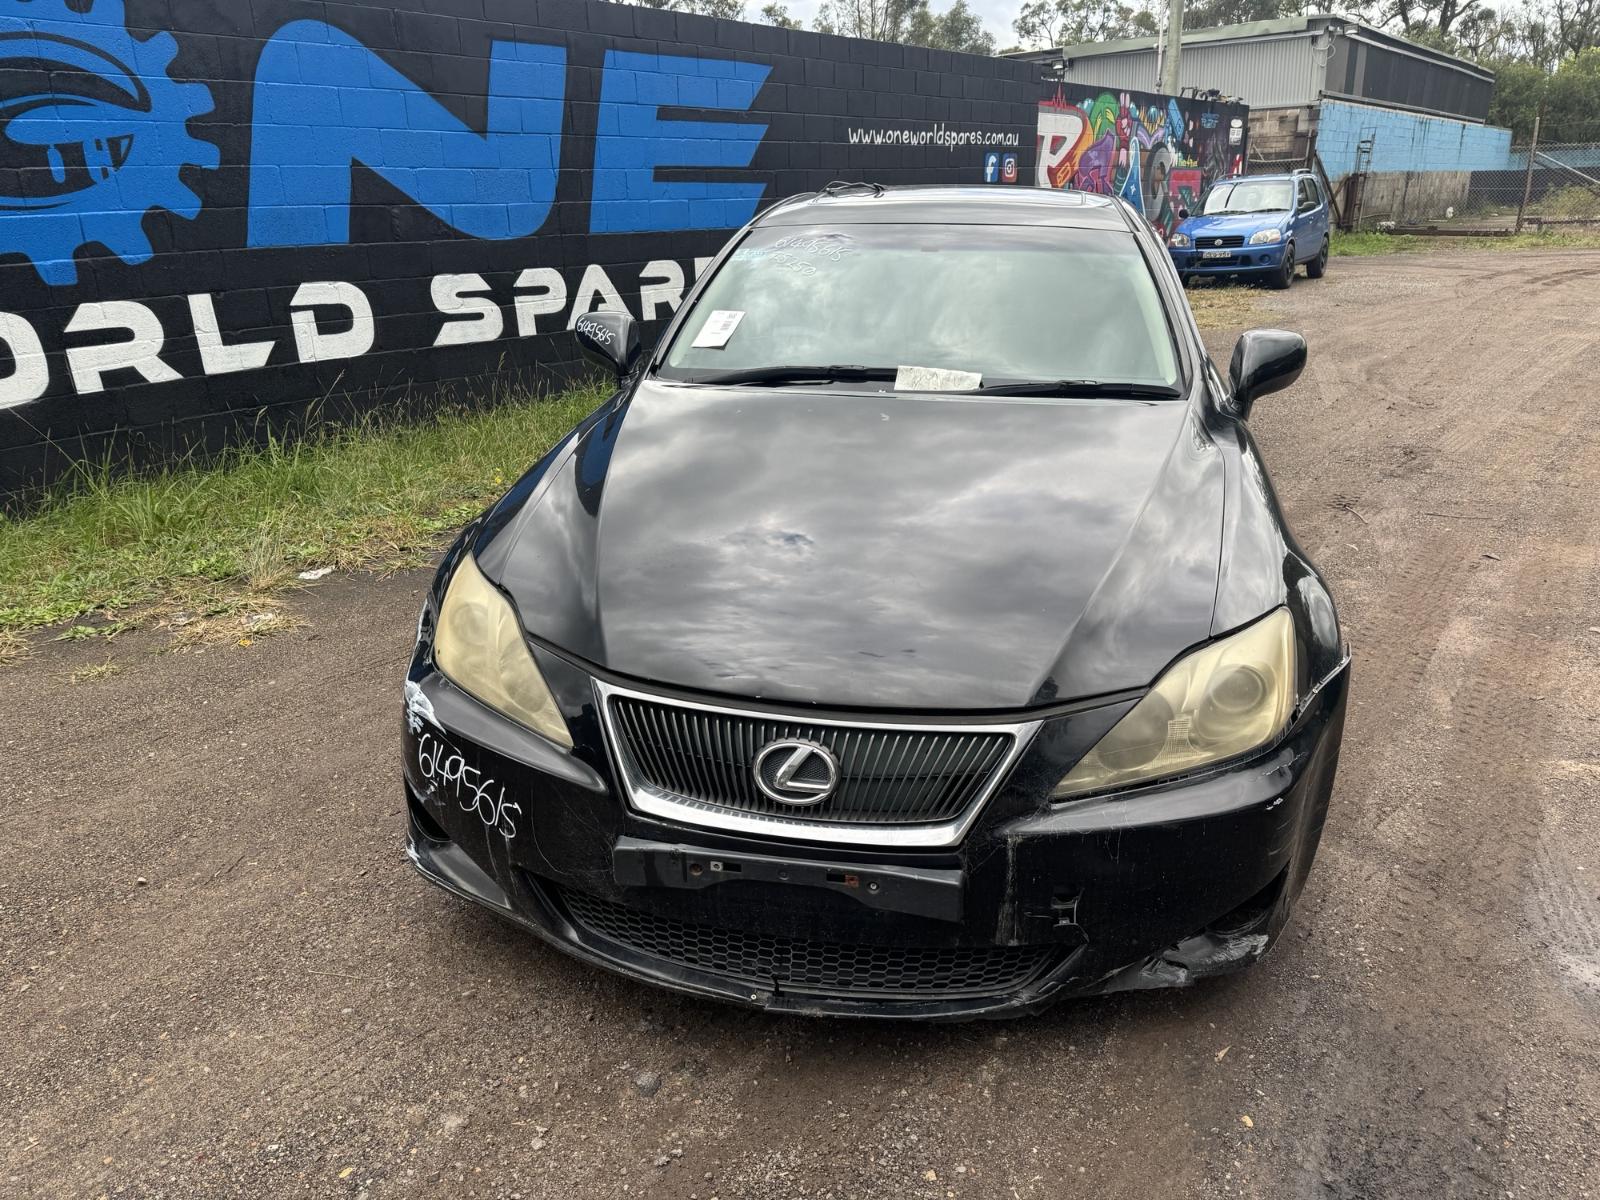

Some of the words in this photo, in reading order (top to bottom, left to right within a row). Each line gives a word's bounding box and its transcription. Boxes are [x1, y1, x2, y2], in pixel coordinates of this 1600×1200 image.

[848, 123, 1019, 152] www.oneworldspares.com.au
[430, 256, 714, 347] SPAR
[419, 734, 521, 838] 61495615
